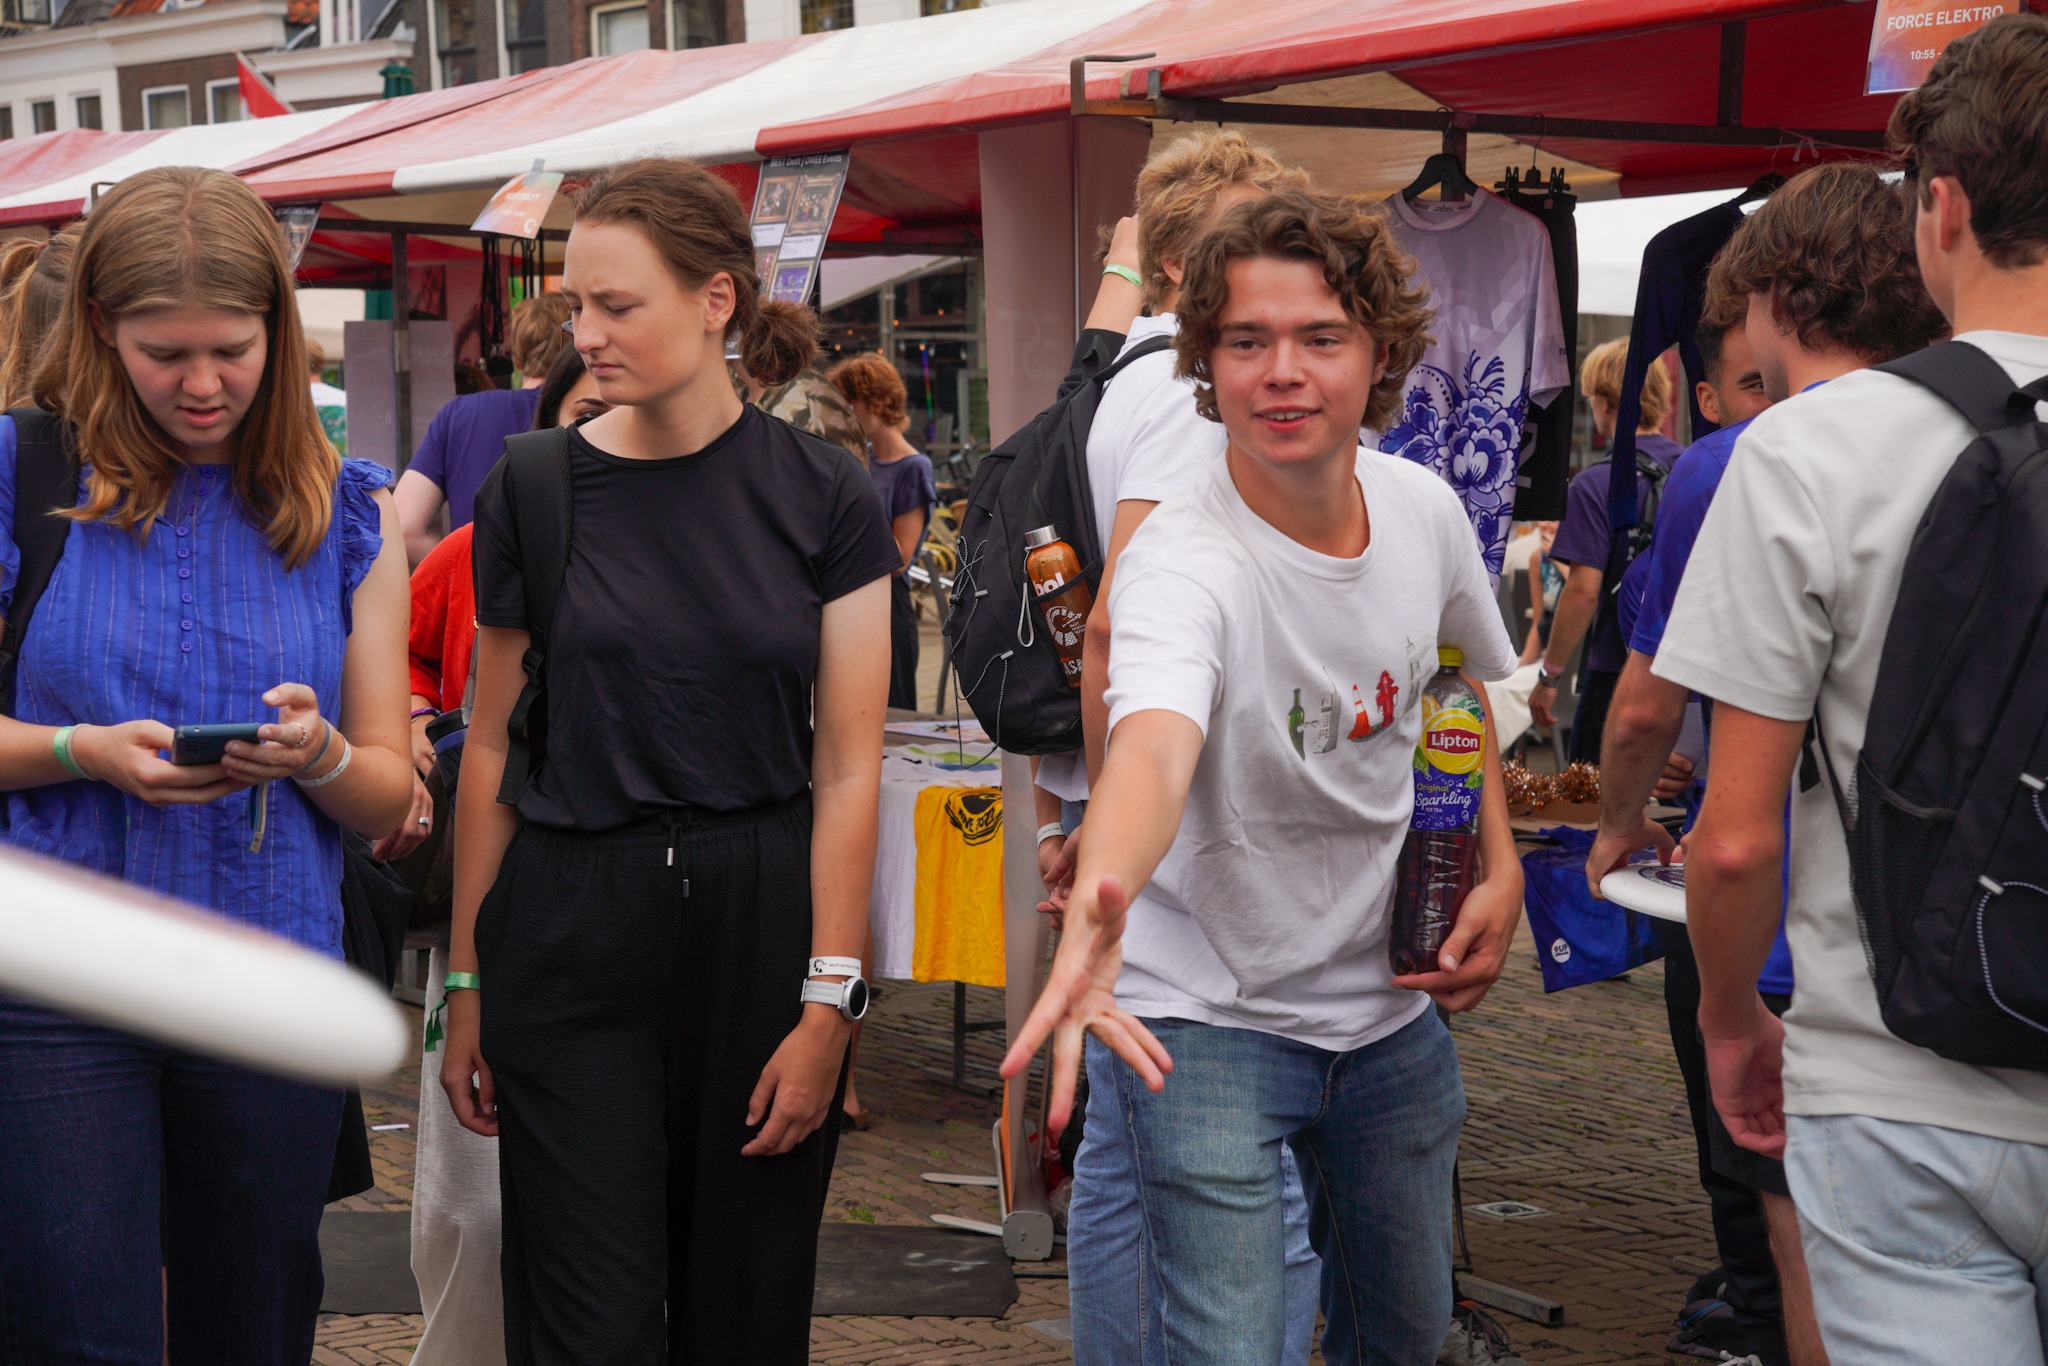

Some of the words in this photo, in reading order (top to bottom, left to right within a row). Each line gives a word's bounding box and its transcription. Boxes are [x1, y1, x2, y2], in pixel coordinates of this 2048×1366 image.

[1887, 12, 1933, 31] FORCE
[1936, 5, 2003, 26] ELEKTRO
[1910, 49, 1935, 60] 10:55
[770, 157, 786, 168] BEST
[805, 155, 823, 165] OWEE
[823, 153, 842, 163] Events
[1431, 733, 1478, 749] Lipton
[1416, 783, 1449, 793] Original
[1415, 791, 1471, 810] Sparkling
